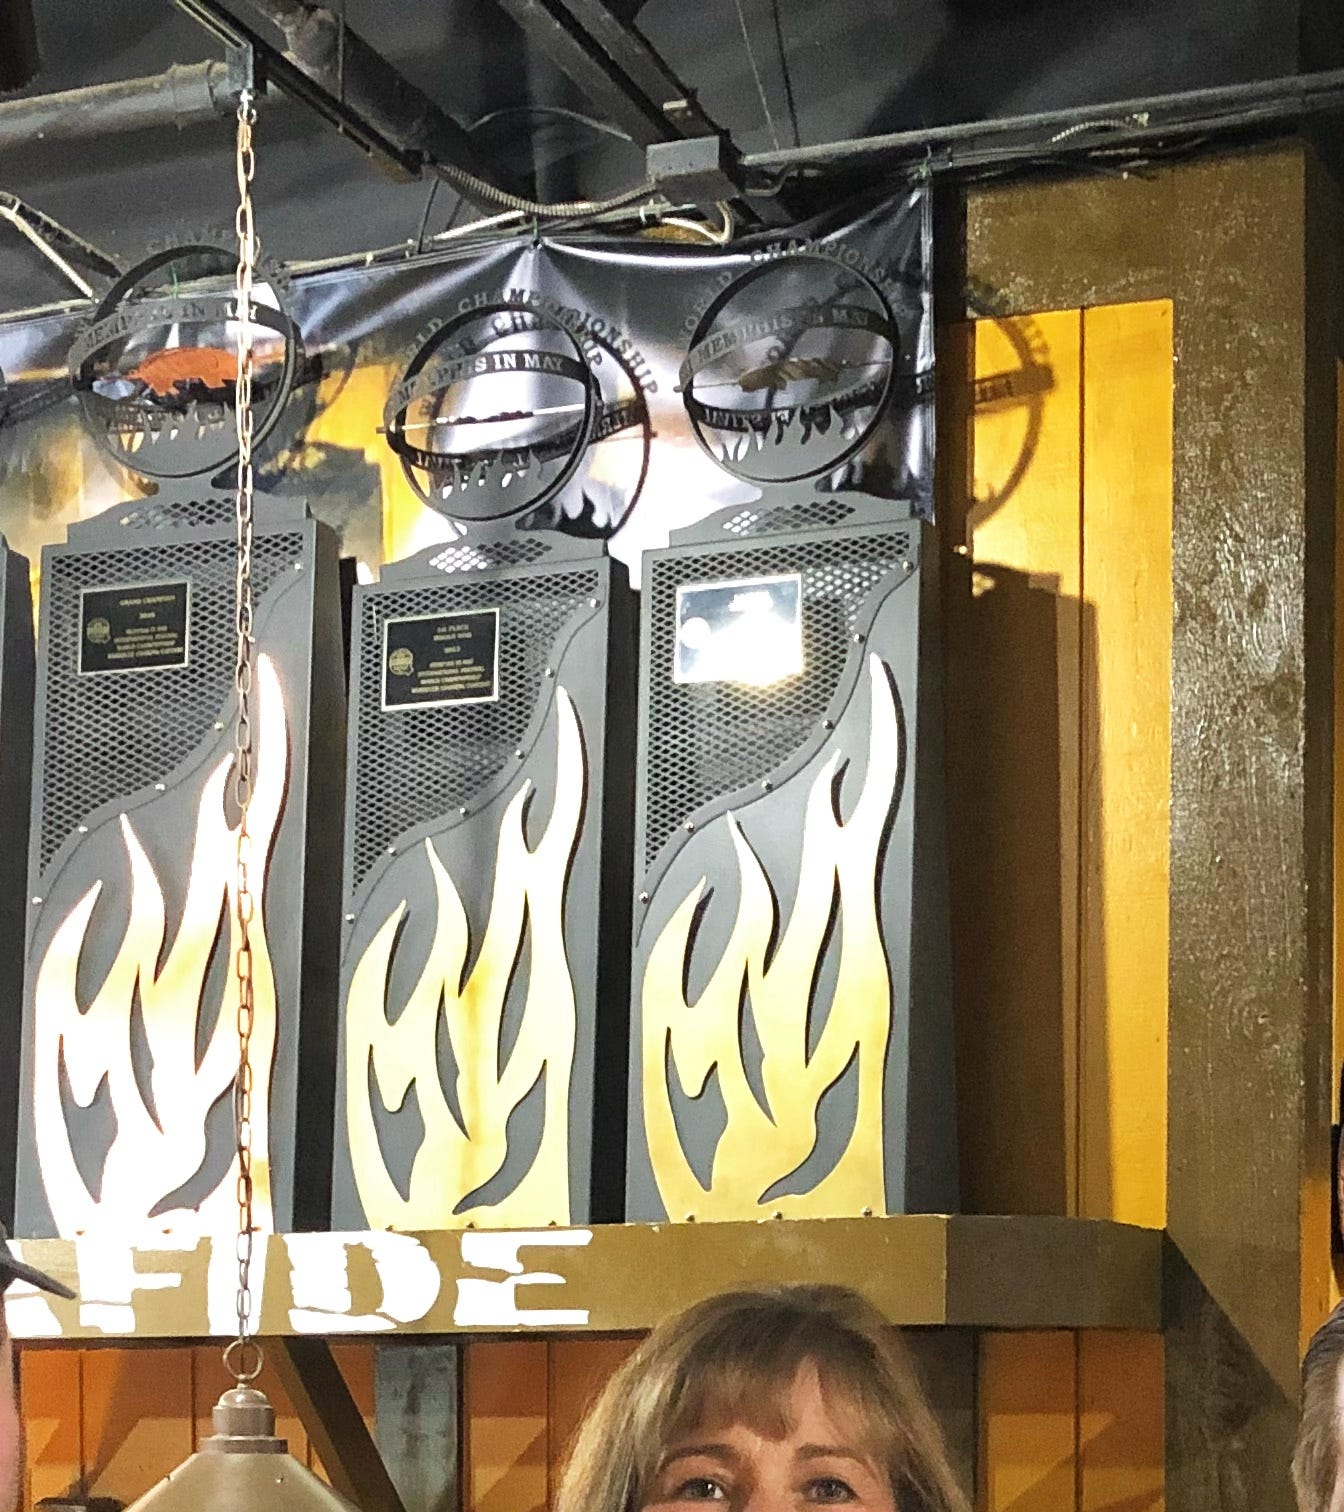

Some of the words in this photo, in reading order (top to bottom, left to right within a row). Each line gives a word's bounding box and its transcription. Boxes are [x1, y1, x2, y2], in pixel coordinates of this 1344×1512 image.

[396, 352, 488, 405] MEPHIS
[493, 352, 517, 370] IN
[524, 352, 564, 371] MAY
